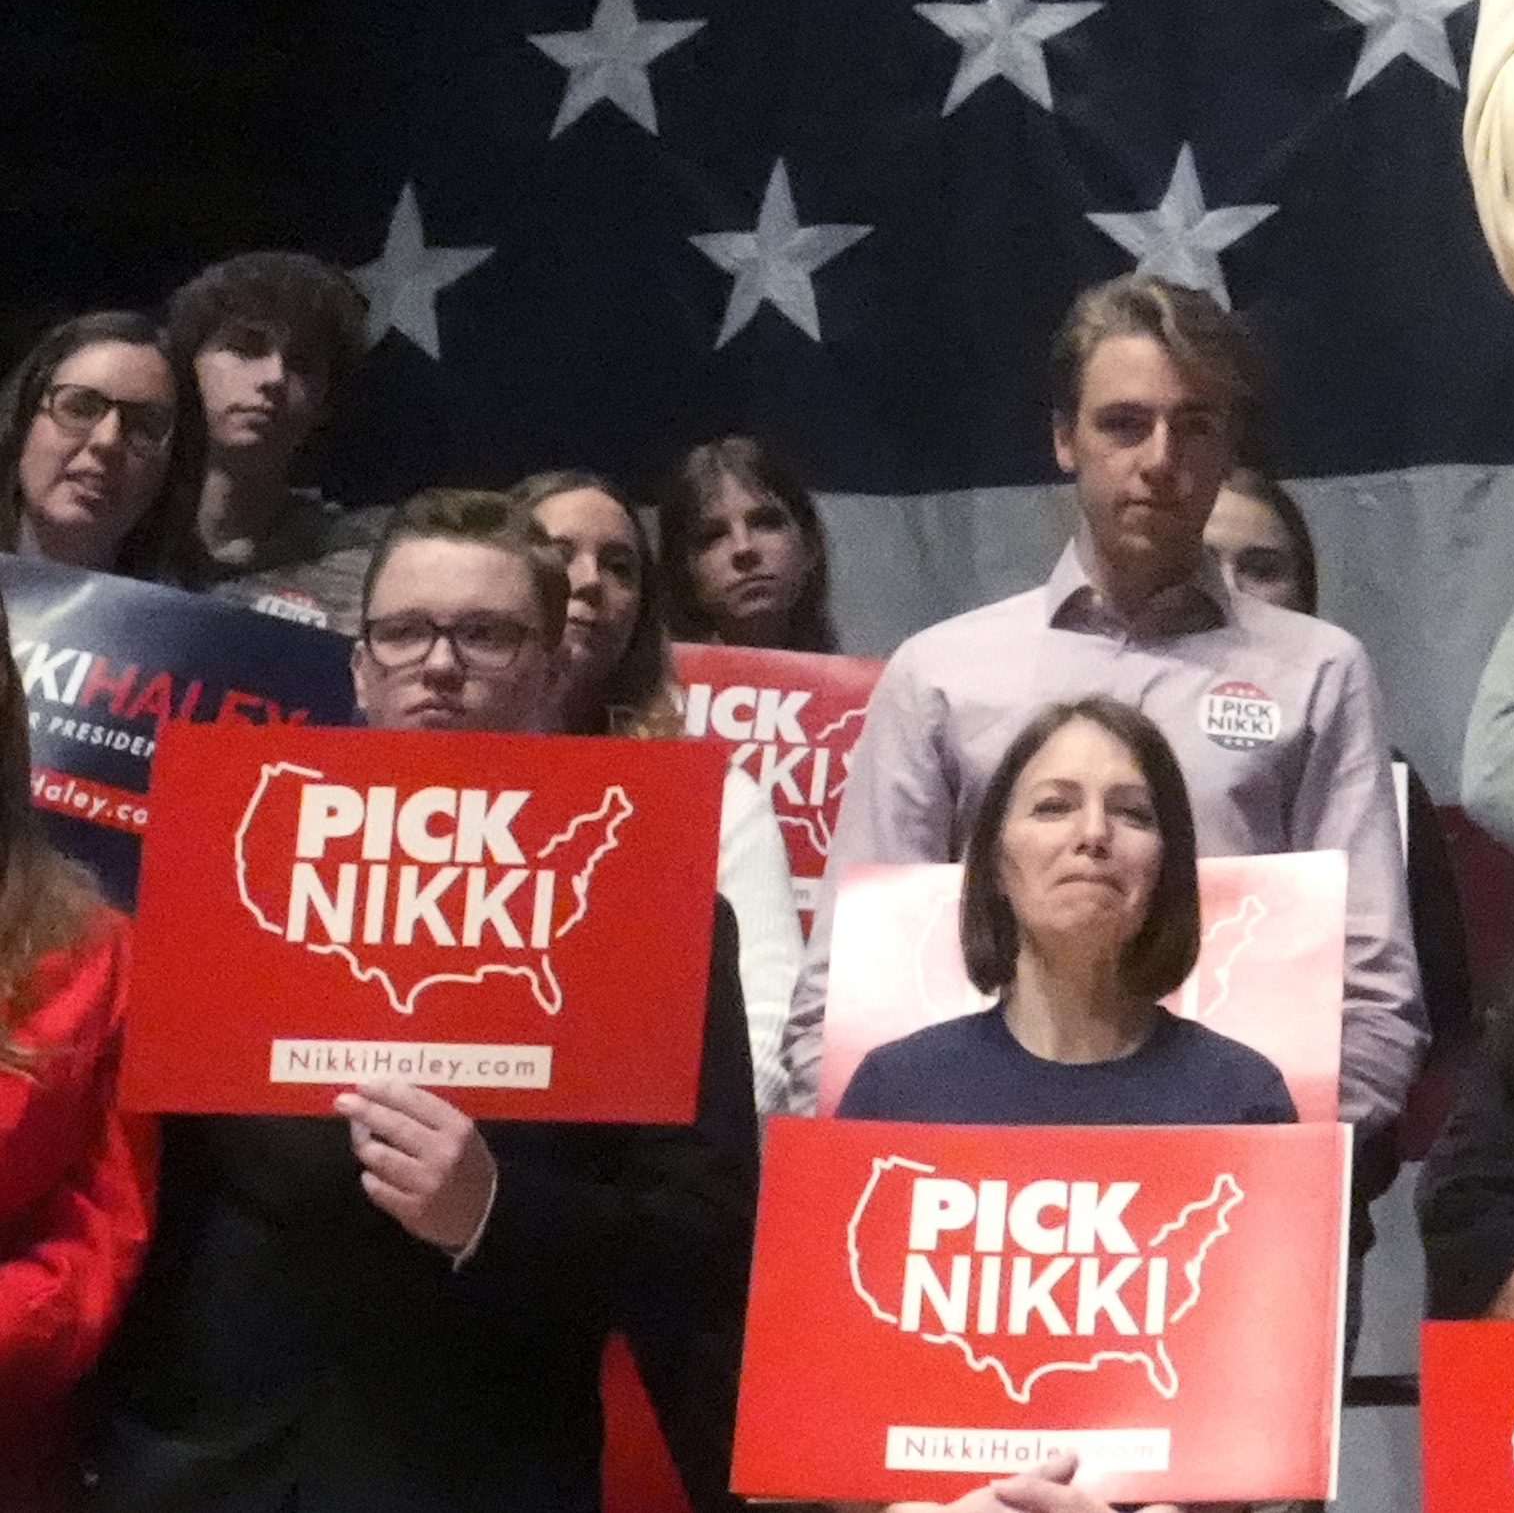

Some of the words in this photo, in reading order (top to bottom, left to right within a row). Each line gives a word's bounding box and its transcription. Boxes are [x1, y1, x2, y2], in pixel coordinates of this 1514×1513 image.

[671, 683, 812, 744] ICK
[1207, 715, 1273, 735] NIKKI
[1208, 698, 1214, 714] I
[1222, 699, 1272, 719] PICK
[295, 783, 533, 865] PICK
[286, 862, 556, 949] NIKKI
[288, 1049, 535, 1078] NikkiHaley.com
[908, 1177, 1141, 1255] PICK
[900, 1253, 1168, 1336] NIKKI
